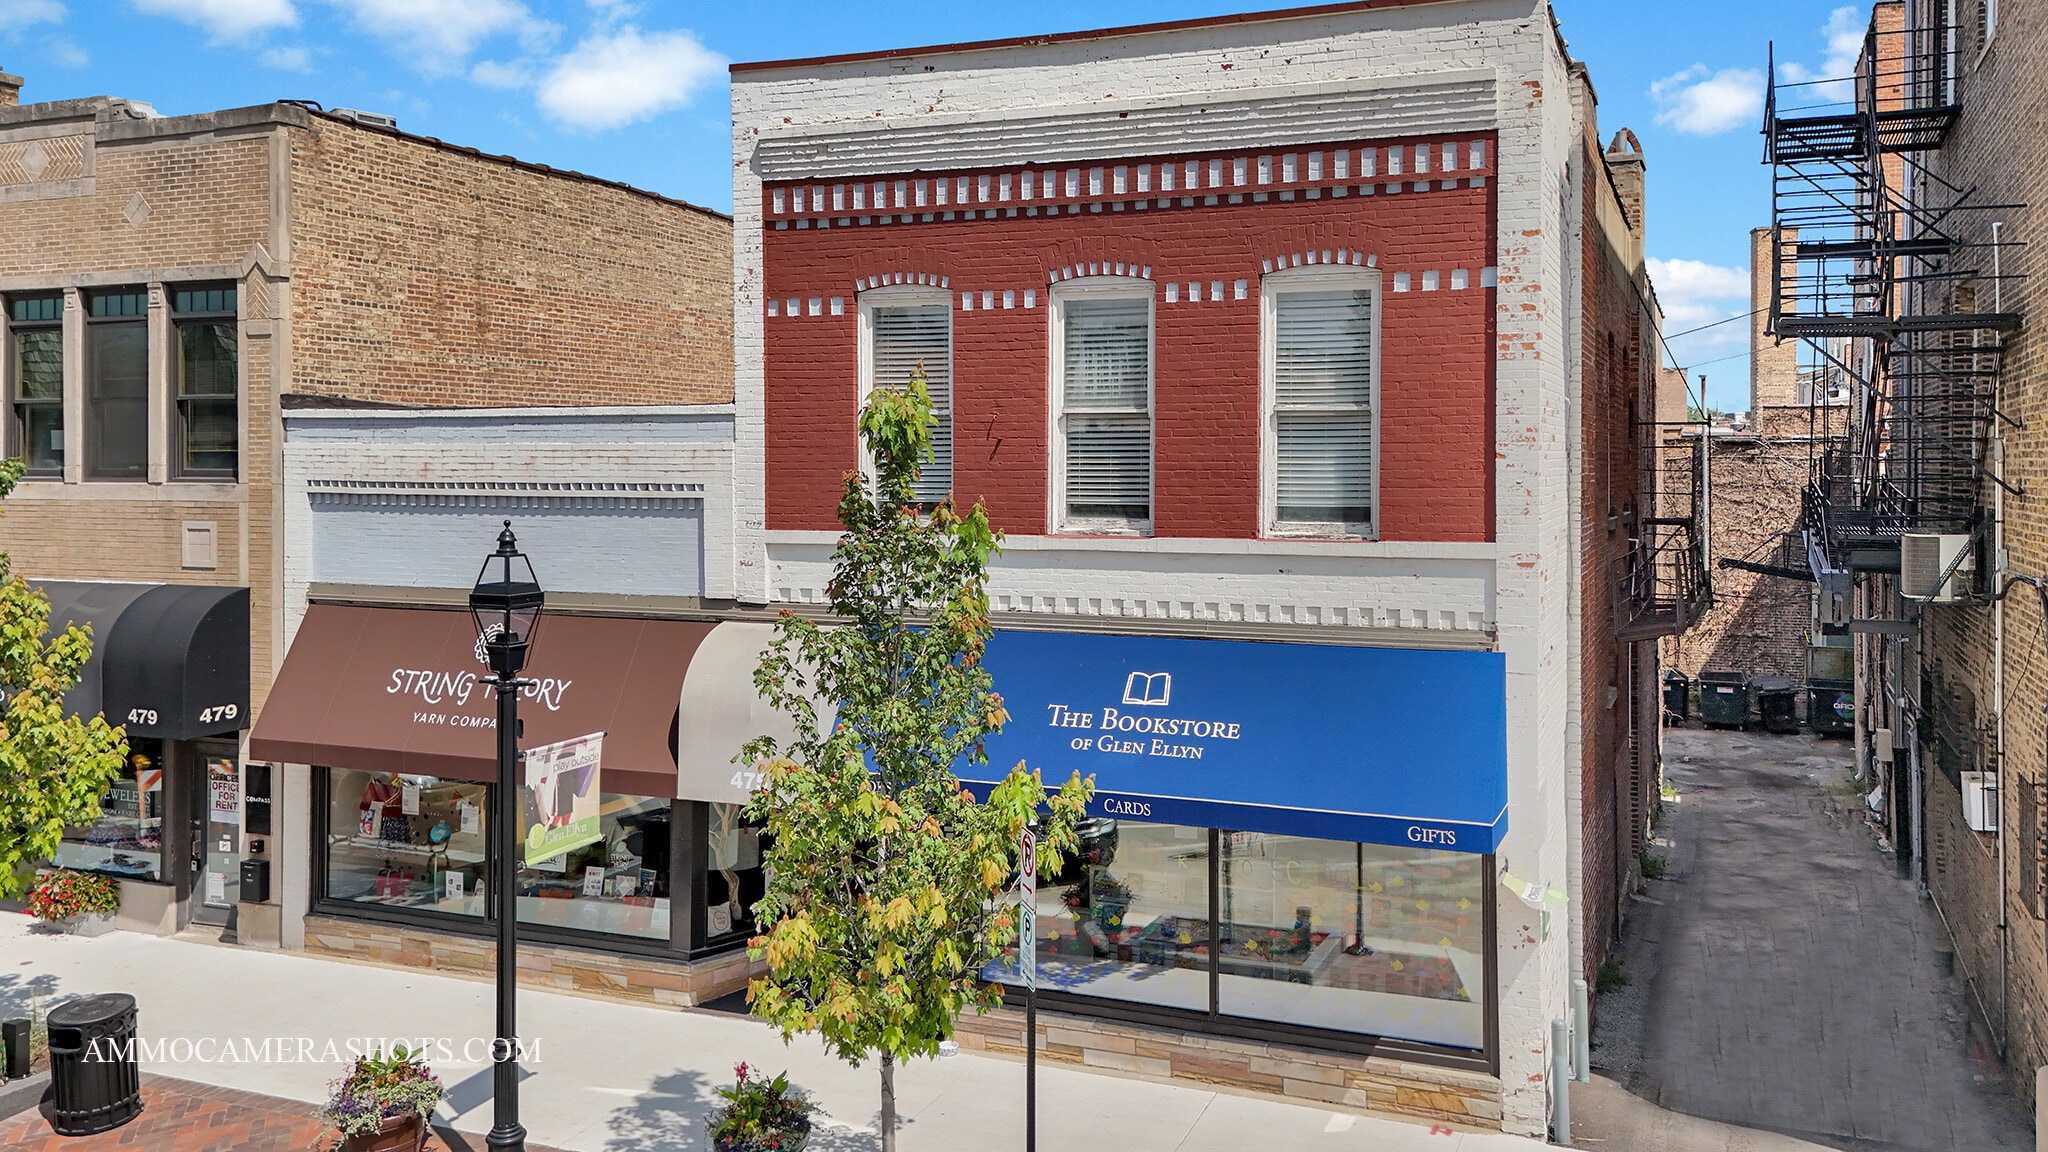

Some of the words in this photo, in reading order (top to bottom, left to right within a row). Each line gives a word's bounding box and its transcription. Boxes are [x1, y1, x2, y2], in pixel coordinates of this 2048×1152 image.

[386, 668, 476, 706] STRING
[484, 674, 572, 711] TORY
[128, 708, 158, 725] 479
[199, 703, 238, 724] 479
[412, 712, 446, 725] YARN
[450, 715, 497, 729] COMPA
[1047, 703, 1093, 729] THE
[1099, 707, 1241, 740] BOOKSTORE
[1070, 737, 1093, 751] OF
[1097, 735, 1145, 755] GLEN
[1149, 738, 1204, 760] ELLYN
[553, 759, 570, 773] play
[571, 751, 600, 767] outside
[100, 788, 151, 804] EWELES
[215, 800, 238, 810] RENT
[218, 791, 235, 801] FOR
[246, 795, 271, 804] COMPASS
[1104, 798, 1151, 817] CARDS
[545, 830, 565, 845] Glen
[566, 823, 587, 838] Ellyn
[1407, 826, 1456, 845] GIFTS
